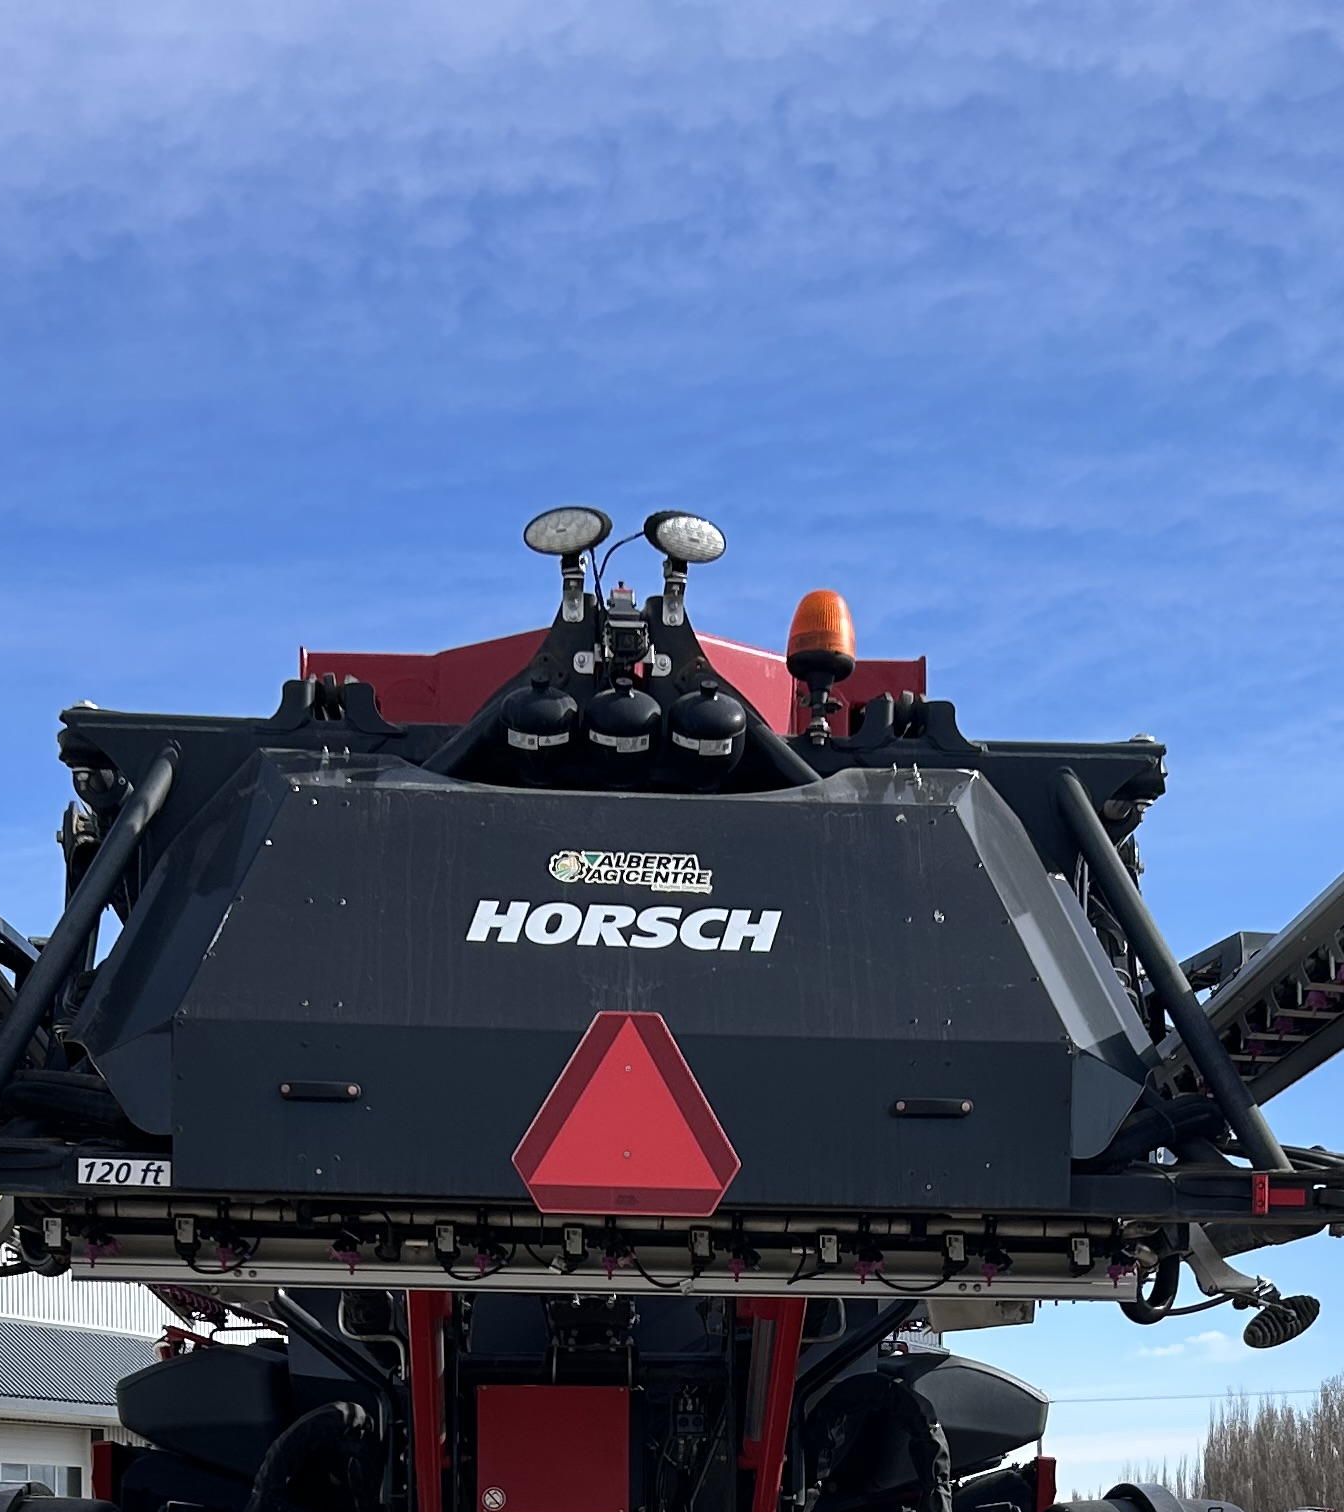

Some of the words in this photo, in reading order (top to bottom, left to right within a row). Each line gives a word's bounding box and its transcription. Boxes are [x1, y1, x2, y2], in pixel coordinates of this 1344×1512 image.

[598, 854, 697, 870] ALBERTA
[588, 869, 618, 882] AG
[625, 870, 710, 885] CENTRE
[466, 900, 782, 952] HORSCH
[84, 1161, 131, 1184] 120
[140, 1161, 164, 1185] ft
